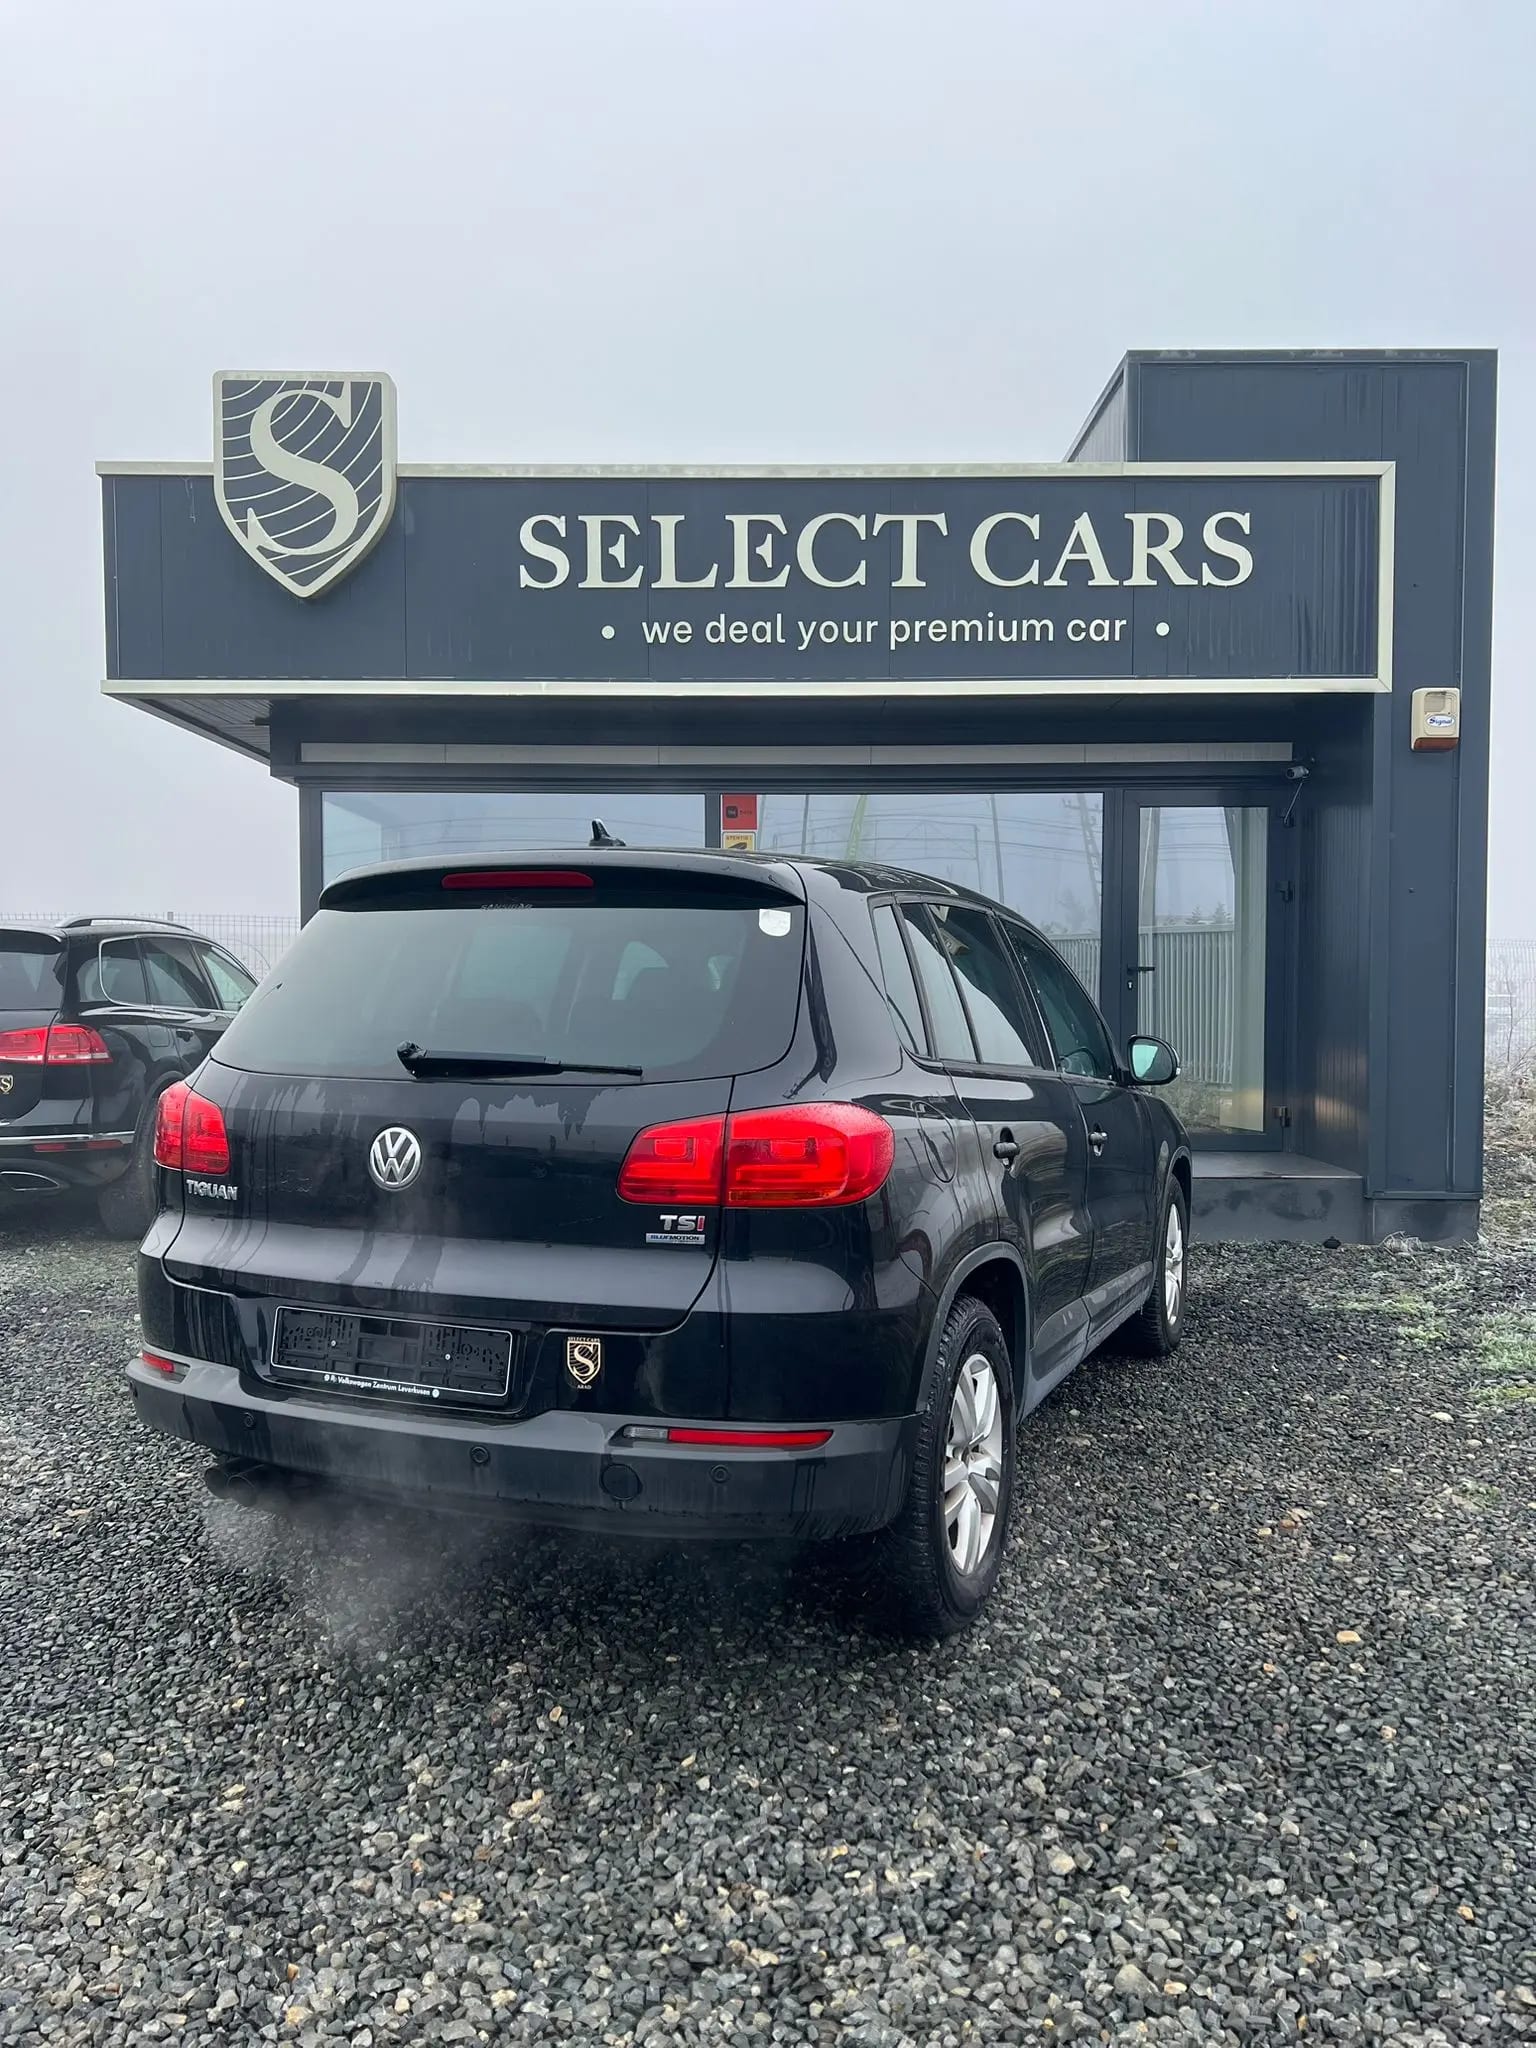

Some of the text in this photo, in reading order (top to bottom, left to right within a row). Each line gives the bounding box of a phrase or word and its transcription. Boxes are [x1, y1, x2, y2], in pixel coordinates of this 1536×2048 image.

[518, 511, 1254, 589] SELECT CARS
[642, 611, 1128, 651] we deal your premium car
[186, 1179, 238, 1201] TIGUAN
[660, 1214, 706, 1232] TSI
[337, 1376, 372, 1388] Volkswagen
[372, 1381, 397, 1391] Zentrum
[397, 1384, 431, 1396] Leverkusen
